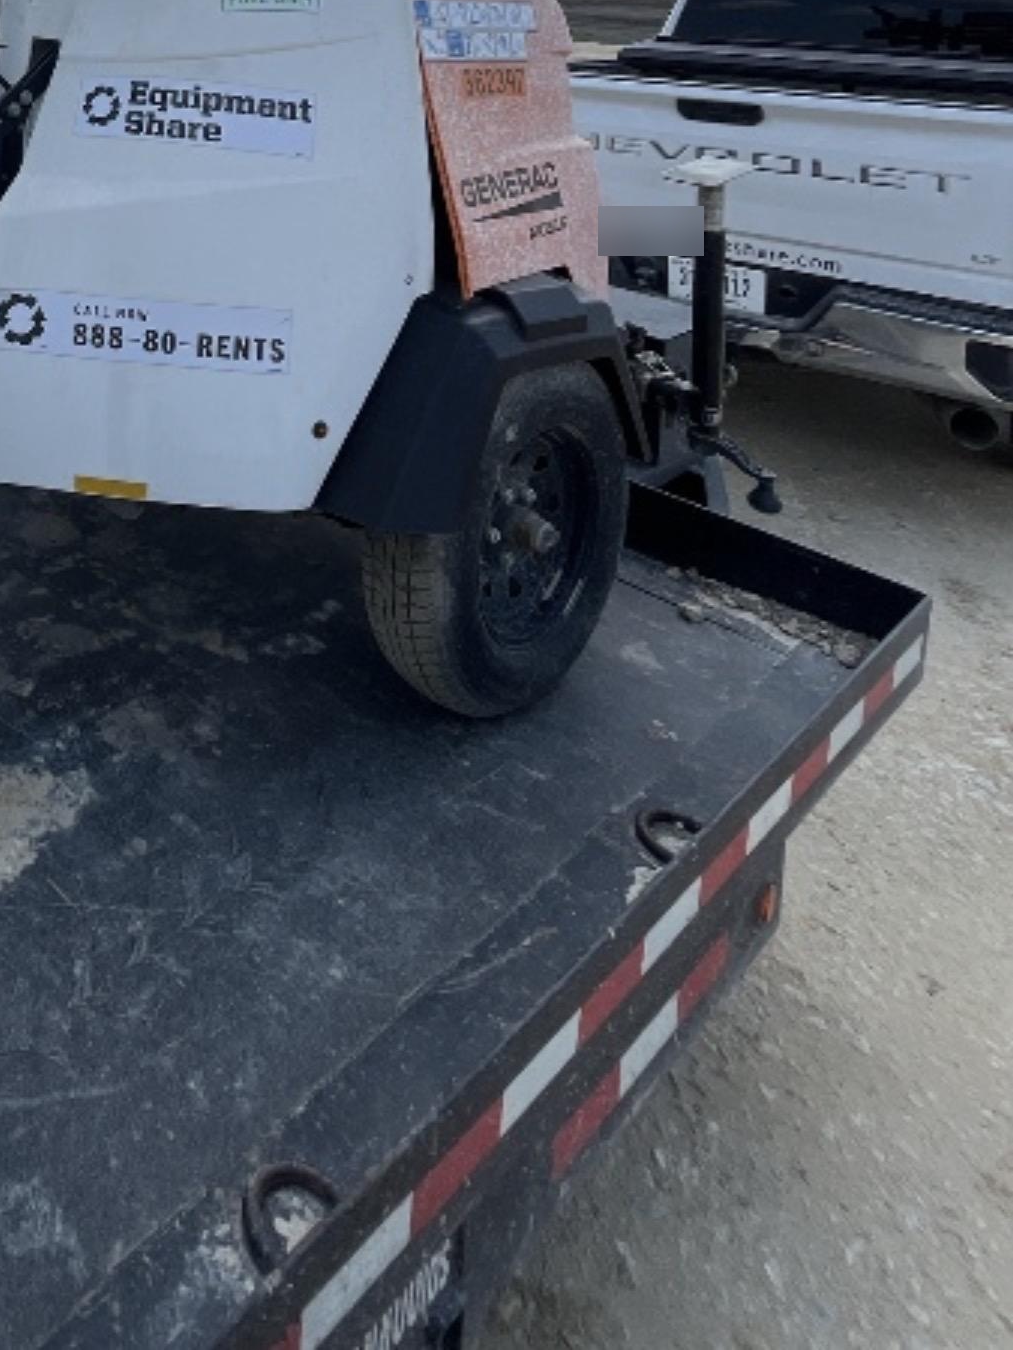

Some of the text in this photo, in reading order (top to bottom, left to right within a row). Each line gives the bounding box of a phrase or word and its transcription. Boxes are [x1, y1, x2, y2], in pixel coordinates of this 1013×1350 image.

[130, 80, 312, 124] Equipment
[124, 110, 222, 142] Share
[461, 161, 559, 207] GENERAC
[585, 132, 972, 194] EVROLET
[73, 323, 286, 363] 888-80-RENTS
